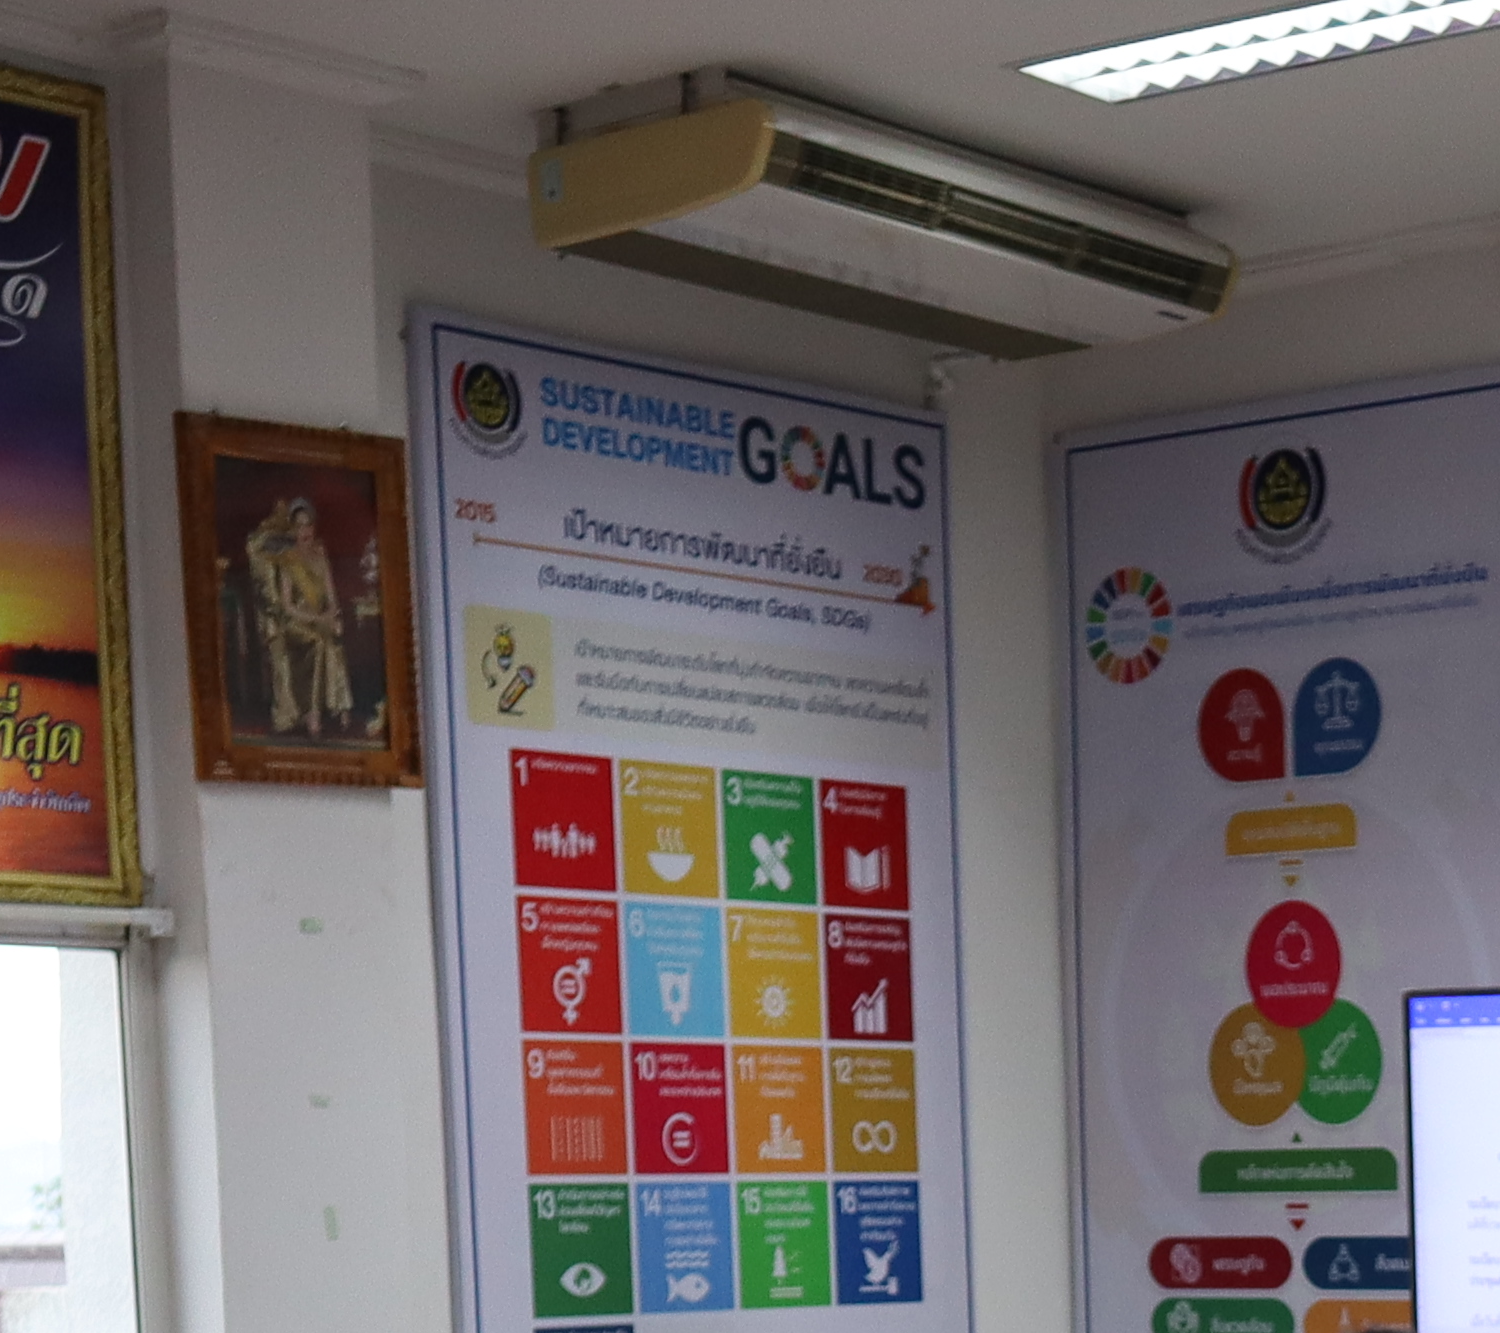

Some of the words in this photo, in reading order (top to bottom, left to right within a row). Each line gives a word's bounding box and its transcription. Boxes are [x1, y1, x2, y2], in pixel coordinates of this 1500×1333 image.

[540, 377, 736, 440] SUSTAINABLE
[541, 416, 736, 477] DEVELOPMENT
[738, 415, 927, 511] GOALS
[537, 562, 648, 602] (Sustainable
[650, 580, 763, 620] Development
[514, 757, 530, 787] 1
[623, 767, 641, 797] 2
[725, 776, 743, 806] 3
[520, 901, 540, 932] 5
[728, 914, 745, 943] 7
[826, 920, 845, 949] 8
[527, 1048, 546, 1079] 9
[634, 1051, 658, 1082] 10
[736, 1053, 758, 1083] 11
[833, 1055, 853, 1084] 12
[533, 1189, 556, 1220] 13
[640, 1187, 663, 1217] 14
